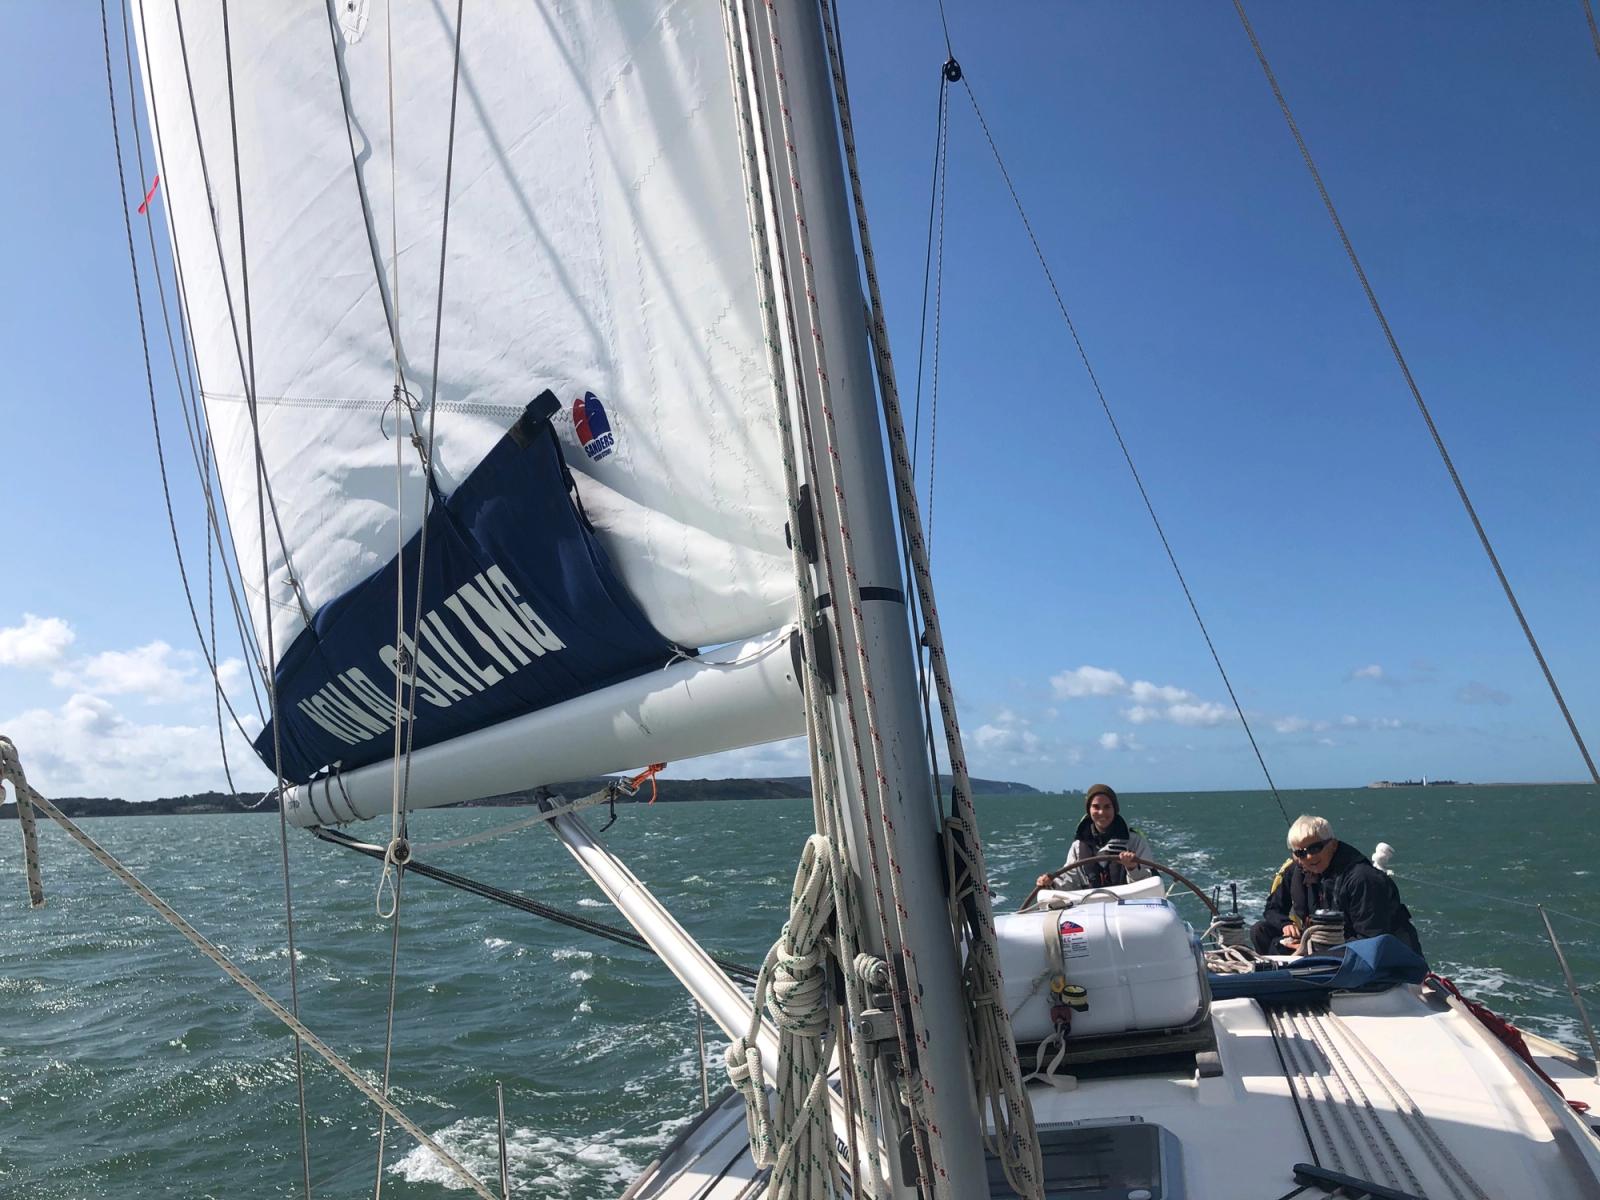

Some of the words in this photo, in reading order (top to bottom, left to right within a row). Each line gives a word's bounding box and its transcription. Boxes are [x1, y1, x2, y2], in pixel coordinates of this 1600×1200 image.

[584, 432, 615, 458] SANDERS
[297, 667, 418, 745] NOMAD
[379, 564, 567, 707] SAILING
